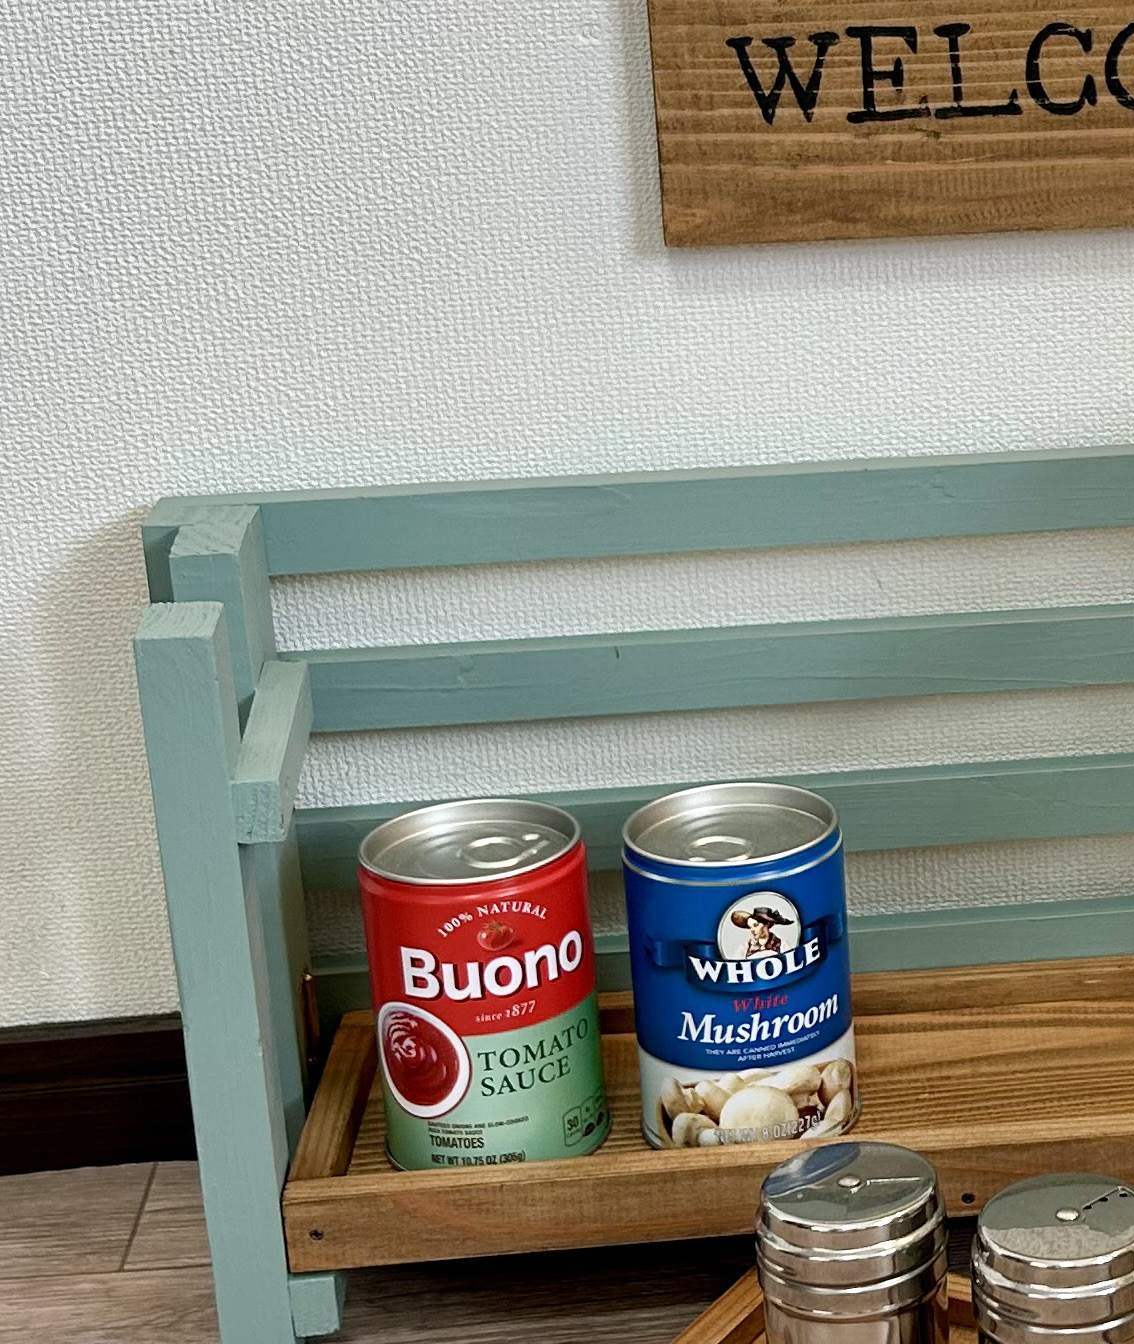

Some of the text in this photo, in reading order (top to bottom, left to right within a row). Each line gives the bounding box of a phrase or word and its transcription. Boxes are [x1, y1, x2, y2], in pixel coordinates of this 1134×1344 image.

[437, 901, 548, 938] 100% NATURAL
[400, 930, 584, 1001] Buono
[688, 937, 821, 984] WHOLE
[475, 999, 537, 1023] since 1877
[677, 993, 839, 1045] Mushroom
[732, 993, 789, 1014] White
[477, 1017, 589, 1071] TOMATO
[481, 1055, 571, 1097] SAUCE
[429, 1134, 486, 1150] TOMATOES
[431, 1153, 446, 1165] NET
[461, 1154, 485, 1167] 10.75
[486, 1154, 499, 1166] OZ
